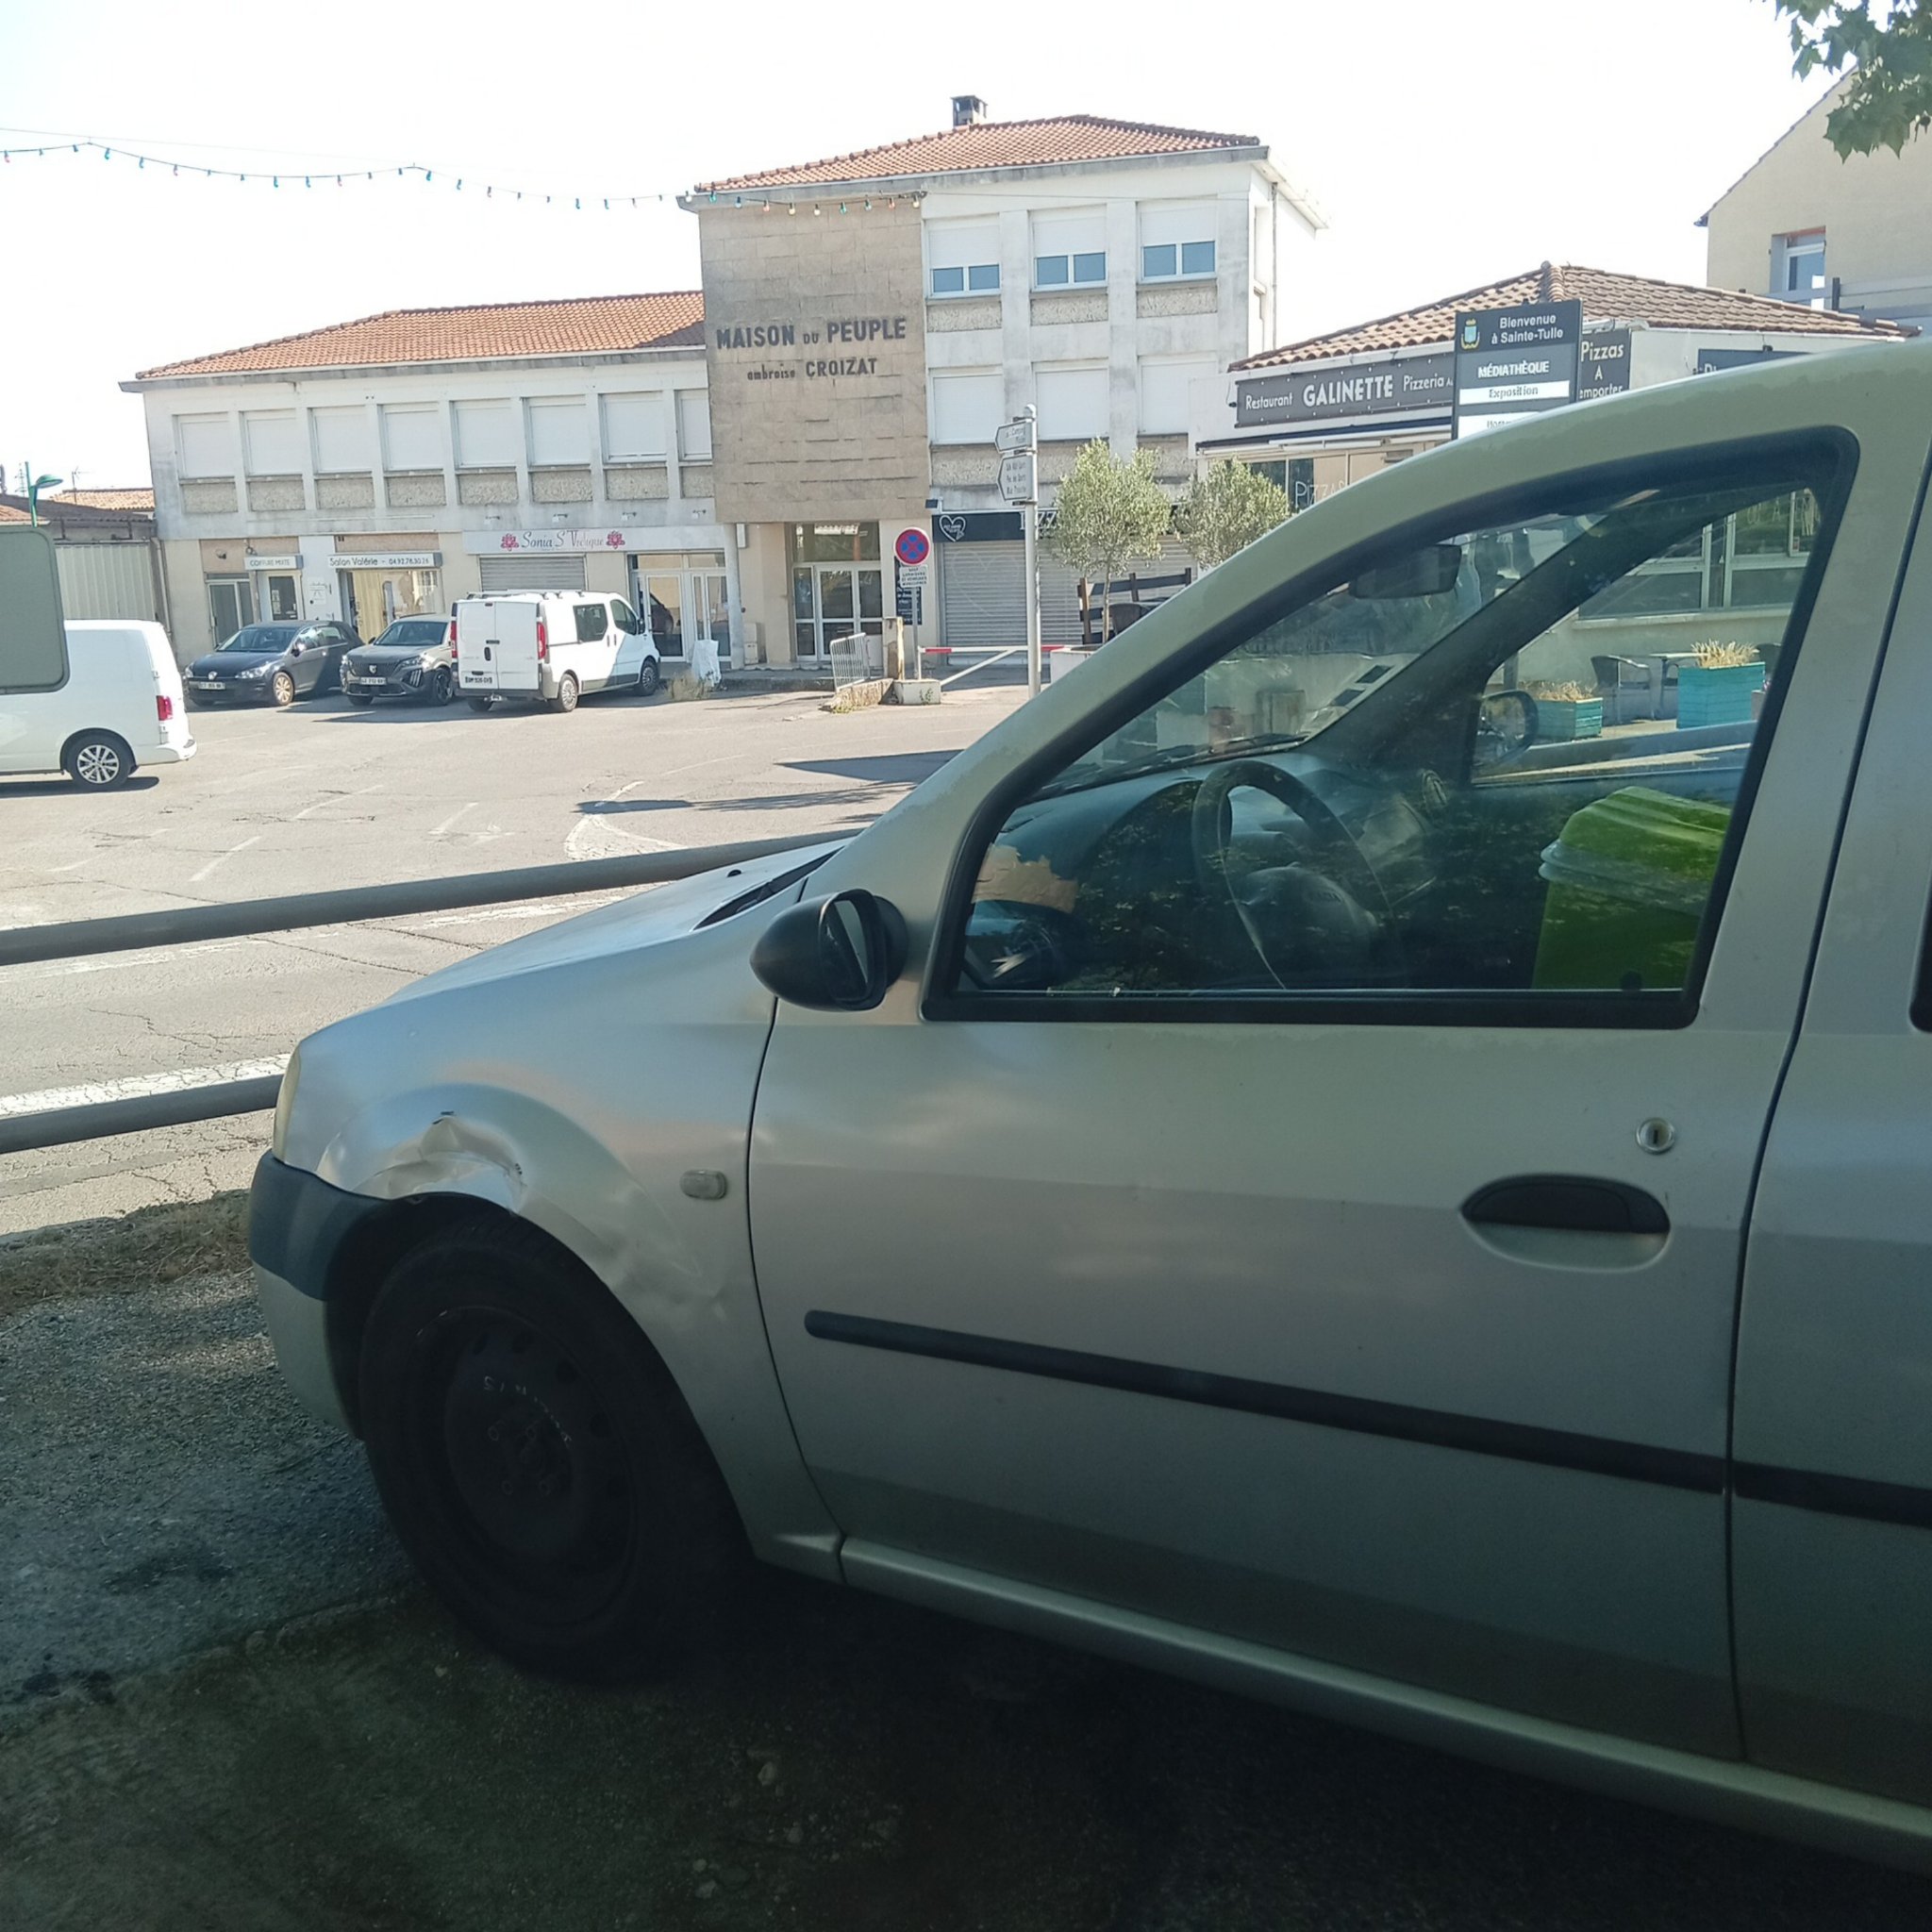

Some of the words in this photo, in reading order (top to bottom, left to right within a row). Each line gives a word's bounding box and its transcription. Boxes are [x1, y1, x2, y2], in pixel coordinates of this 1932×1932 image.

[1499, 314, 1557, 329] Bienvenue
[716, 325, 795, 349] MAISON
[803, 332, 820, 345] DU
[826, 318, 907, 343] PEUPLE
[1491, 332, 1498, 344] à
[1500, 327, 1563, 344] Sainte-Tulle
[1580, 341, 1624, 362] Pizzas
[747, 364, 796, 381] ambroise
[806, 358, 878, 378] CROIZAT
[1477, 359, 1550, 378] MÉDIATHÈQUE
[1594, 365, 1603, 380] A
[1245, 392, 1293, 410] Restaurant
[1303, 375, 1393, 408] GALINETTE
[1403, 373, 1444, 392] Pizzeria
[1489, 387, 1539, 400] Exposition
[522, 530, 553, 548] Sonia
[329, 558, 351, 567] Salon
[352, 557, 378, 566] Valérie
